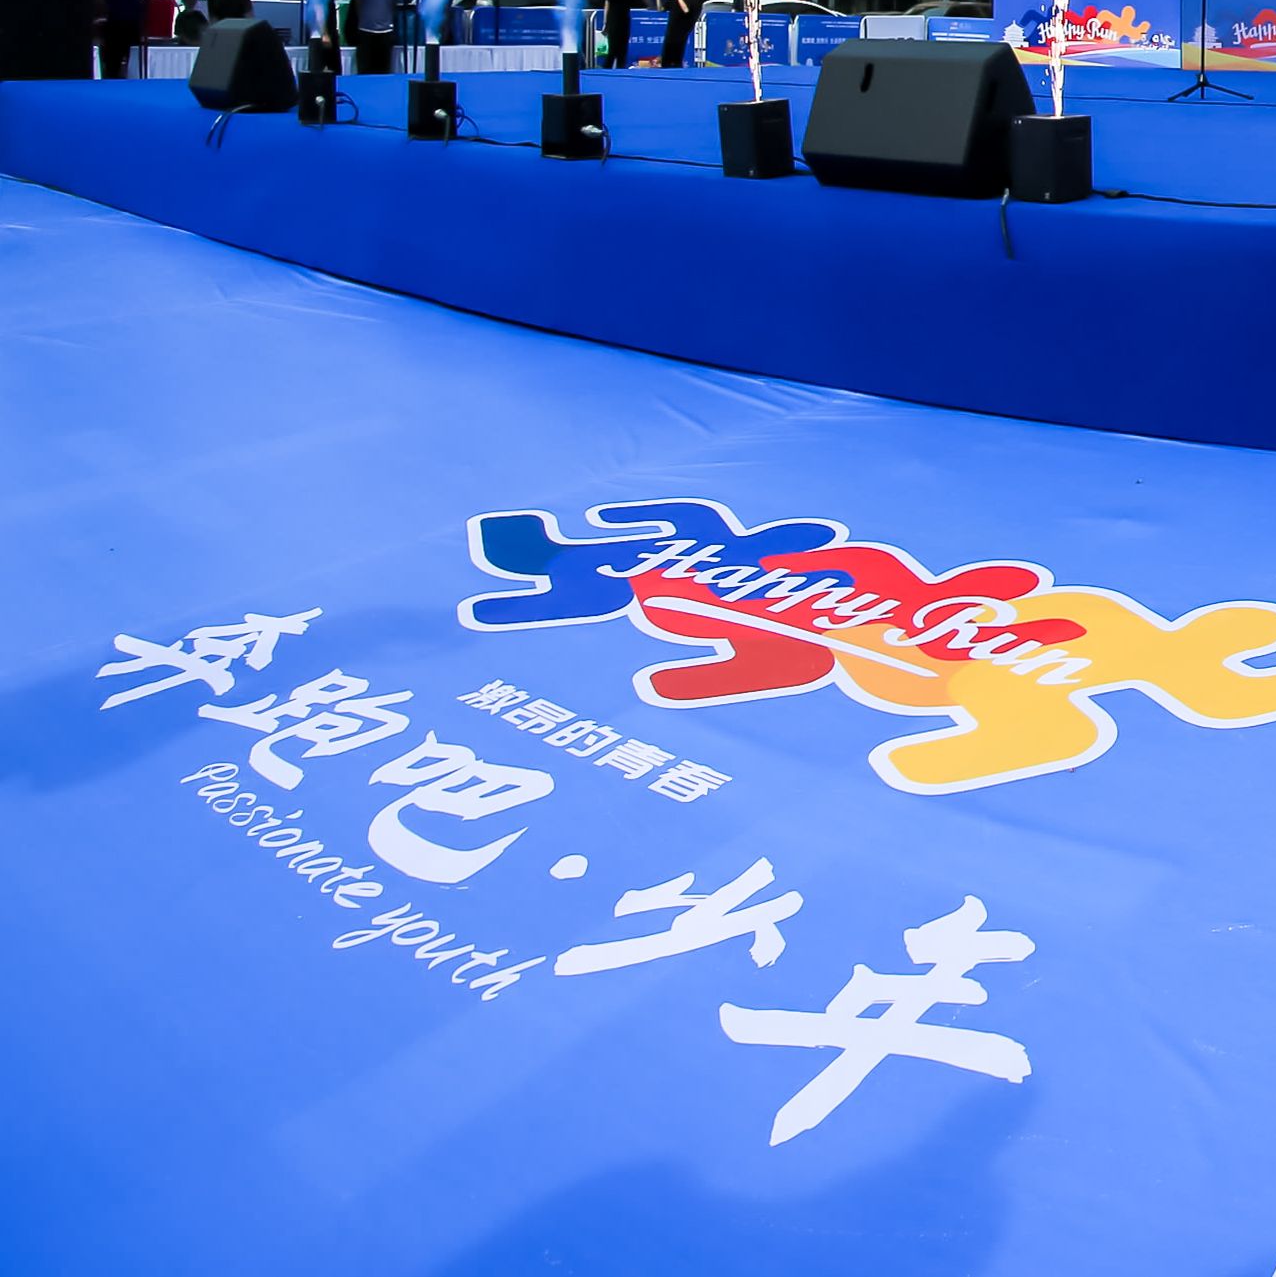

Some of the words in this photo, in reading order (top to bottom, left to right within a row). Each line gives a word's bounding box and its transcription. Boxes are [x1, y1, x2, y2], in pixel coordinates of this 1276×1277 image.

[1086, 17, 1119, 43] Run
[599, 537, 893, 630] Happy
[886, 594, 1094, 686] Run
[455, 679, 733, 804] 激昂的青春
[95, 607, 1036, 1148] 奔跑吧·少年
[180, 762, 384, 909] Passionate
[331, 902, 547, 1002] youth
